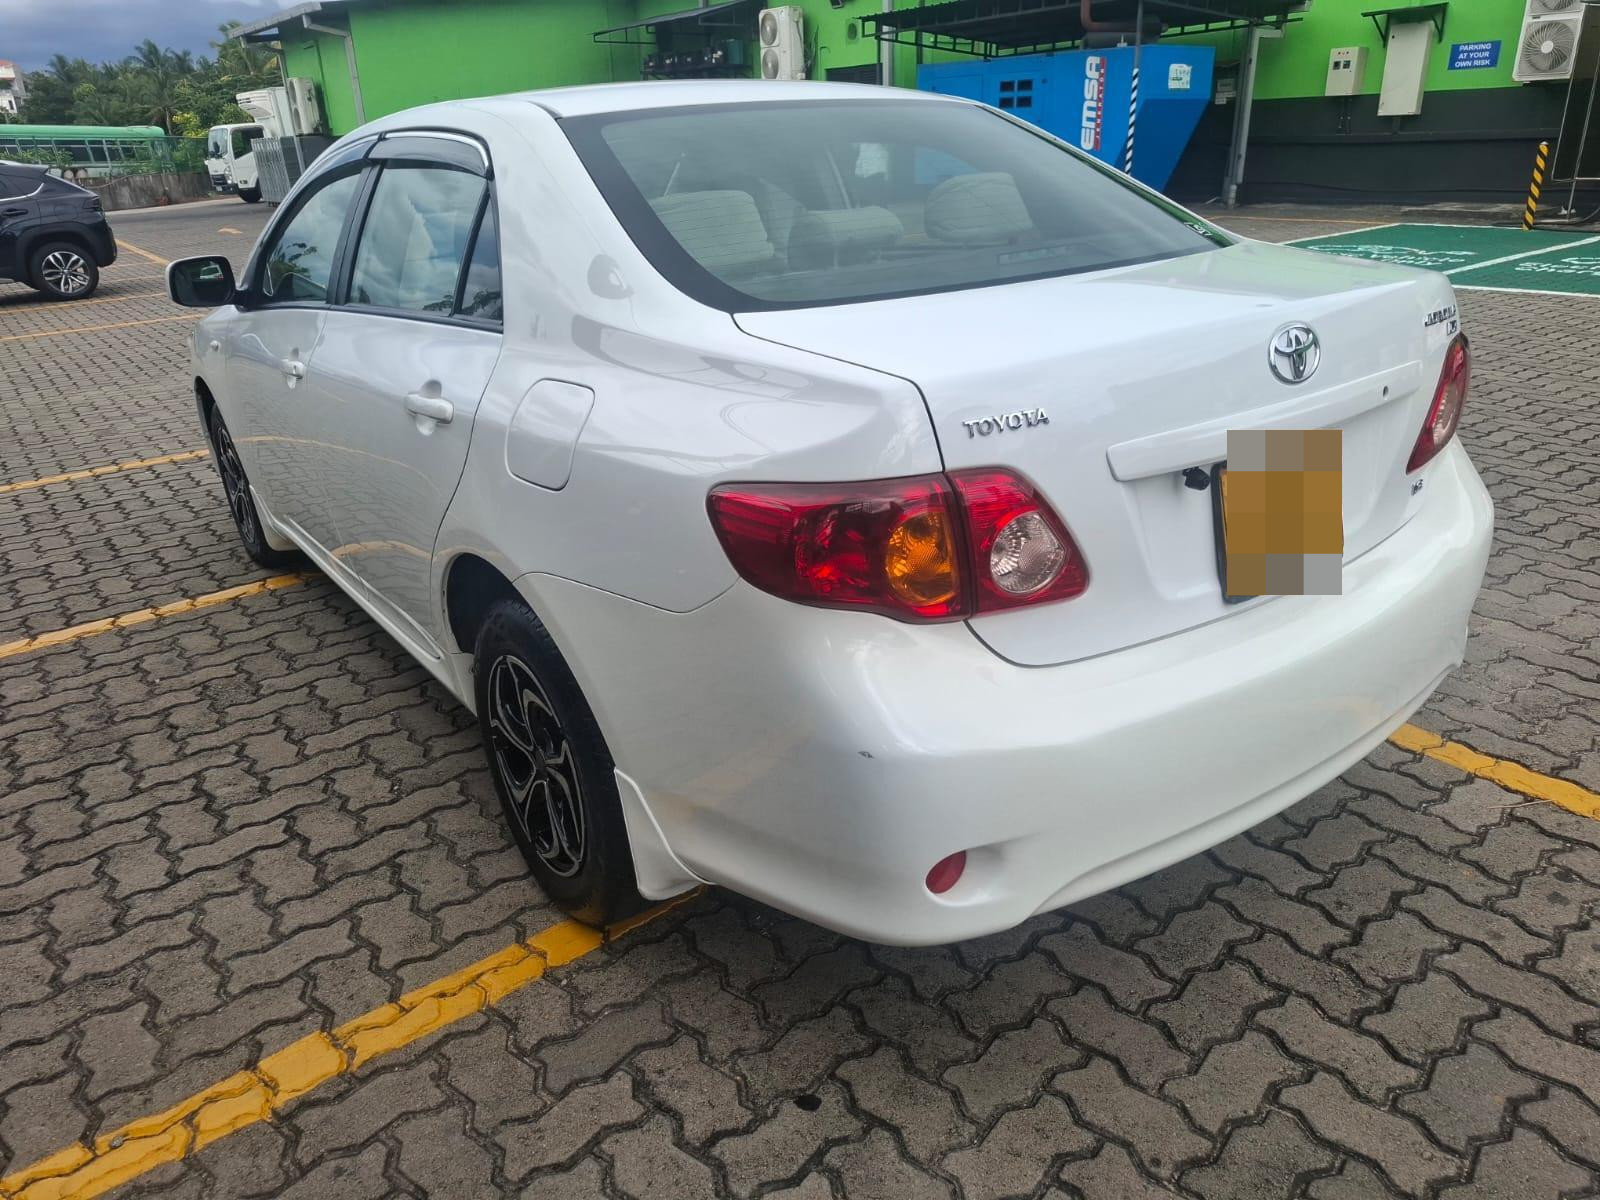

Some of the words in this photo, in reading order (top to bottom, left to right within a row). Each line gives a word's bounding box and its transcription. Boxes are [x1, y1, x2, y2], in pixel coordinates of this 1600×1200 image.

[1459, 43, 1492, 51] PARKING
[1470, 51, 1490, 59] YOUR
[963, 408, 1050, 439] TOYOTA
